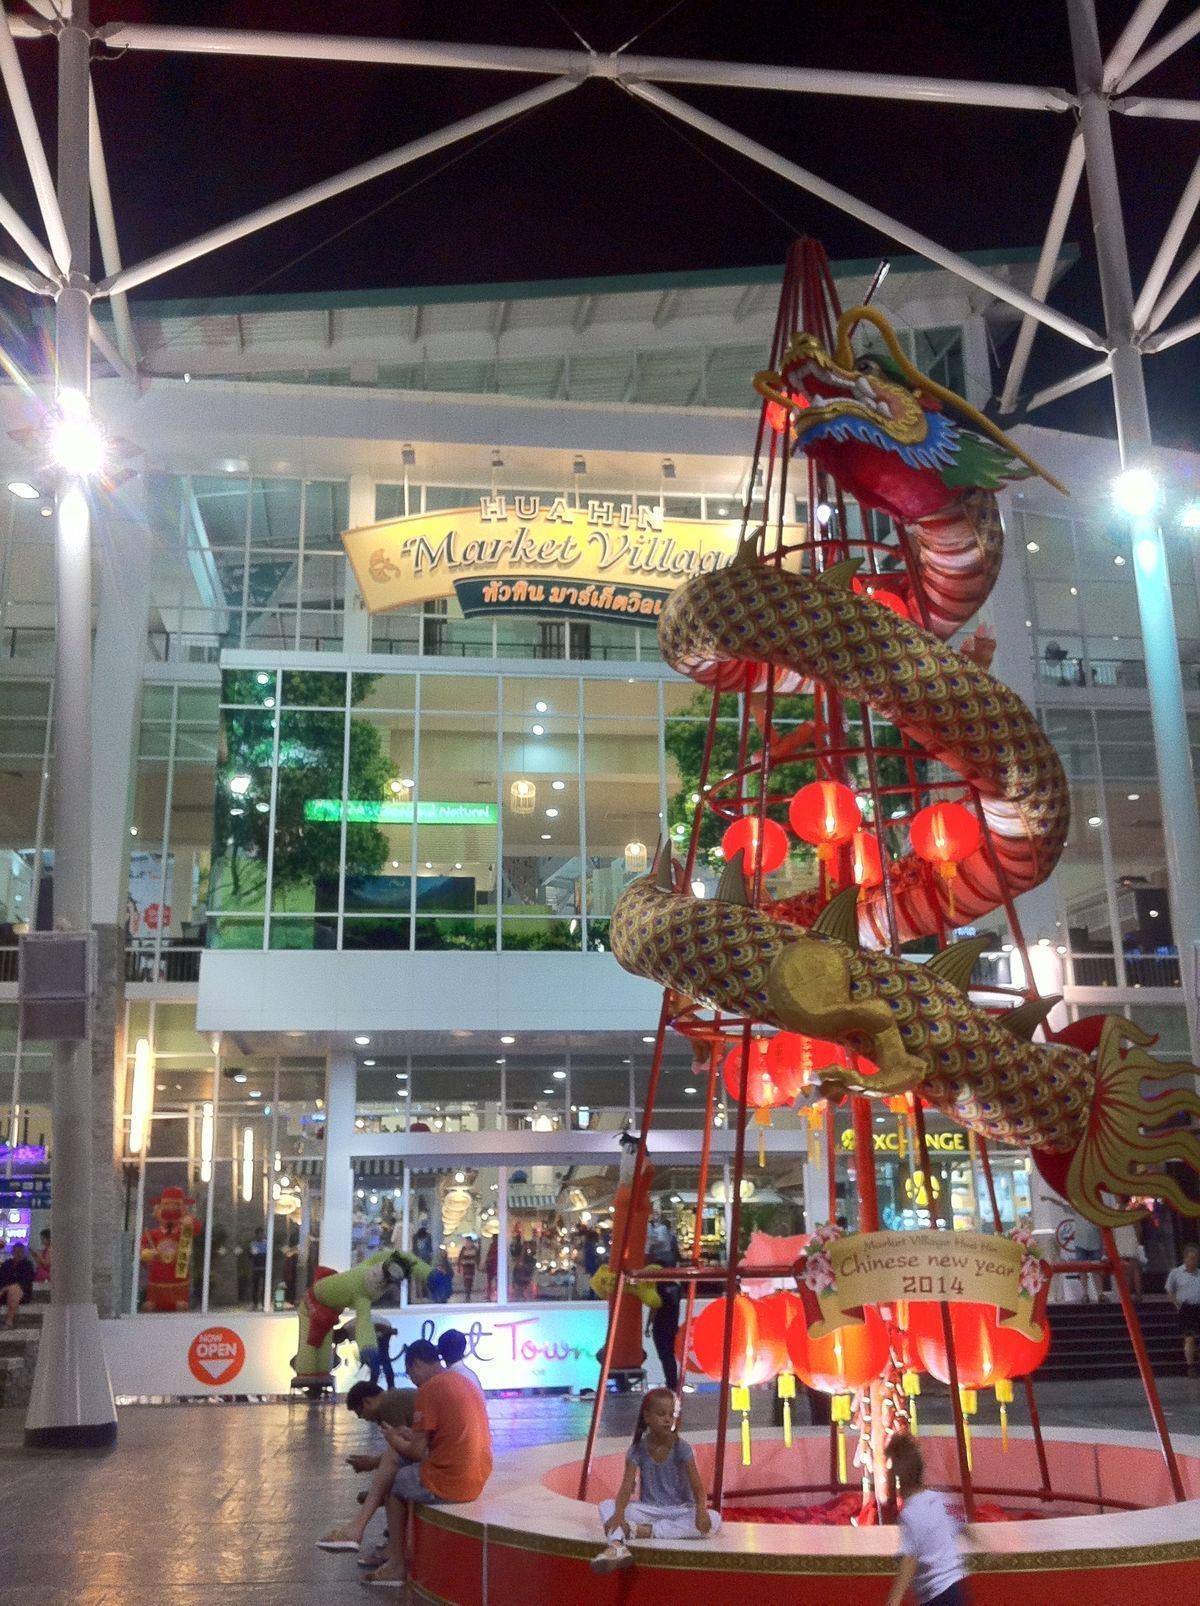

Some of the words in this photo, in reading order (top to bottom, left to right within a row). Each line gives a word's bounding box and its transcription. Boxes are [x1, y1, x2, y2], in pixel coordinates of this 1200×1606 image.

[480, 495, 574, 524] HUA
[587, 499, 663, 532] HIN
[402, 527, 582, 573] Market
[588, 530, 736, 579] Villag
[839, 1252, 920, 1277] Chinese
[928, 1254, 969, 1269] new
[974, 1257, 1015, 1277] year
[903, 1276, 964, 1294] 2014
[196, 1342, 238, 1358] OPEN
[494, 1317, 597, 1361] Town
